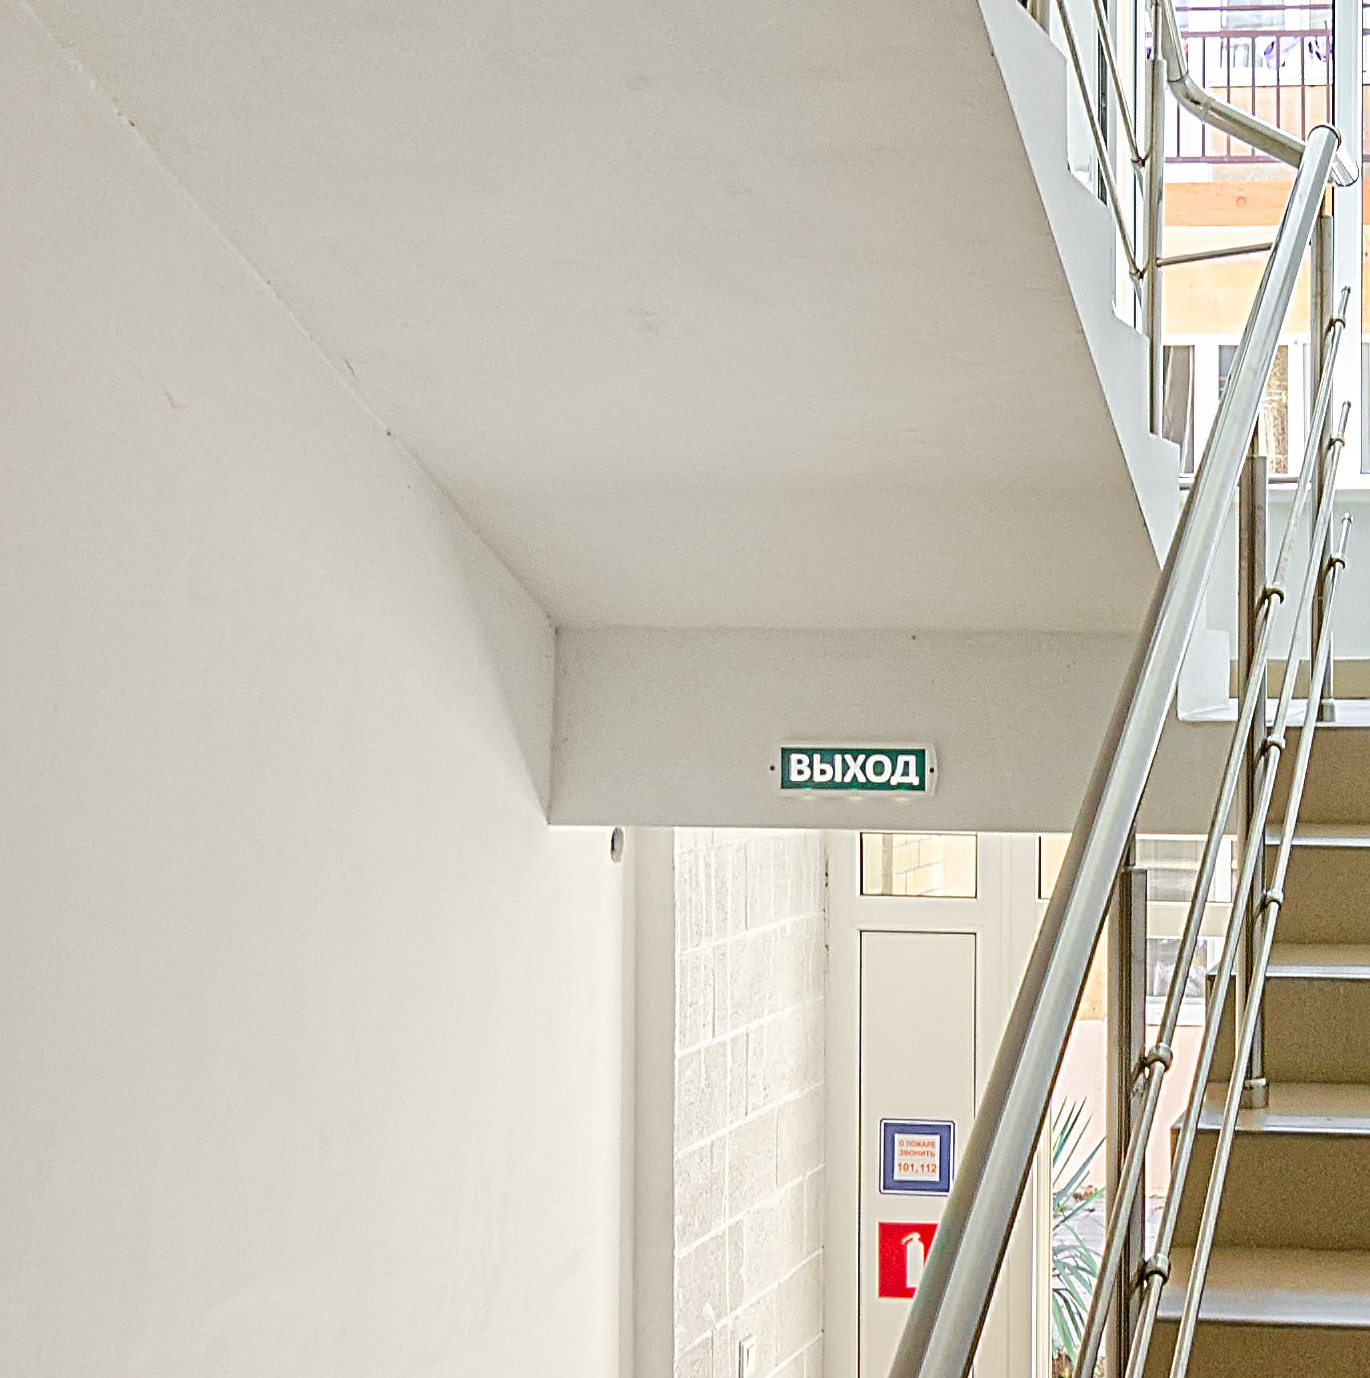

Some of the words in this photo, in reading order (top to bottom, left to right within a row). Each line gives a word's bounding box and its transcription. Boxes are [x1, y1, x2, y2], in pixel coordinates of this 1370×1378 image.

[789, 753, 920, 786] ВЫХОД
[906, 1140, 935, 1148] ПОЖАРЕ
[899, 1149, 935, 1157] ЗВОНИТЬ
